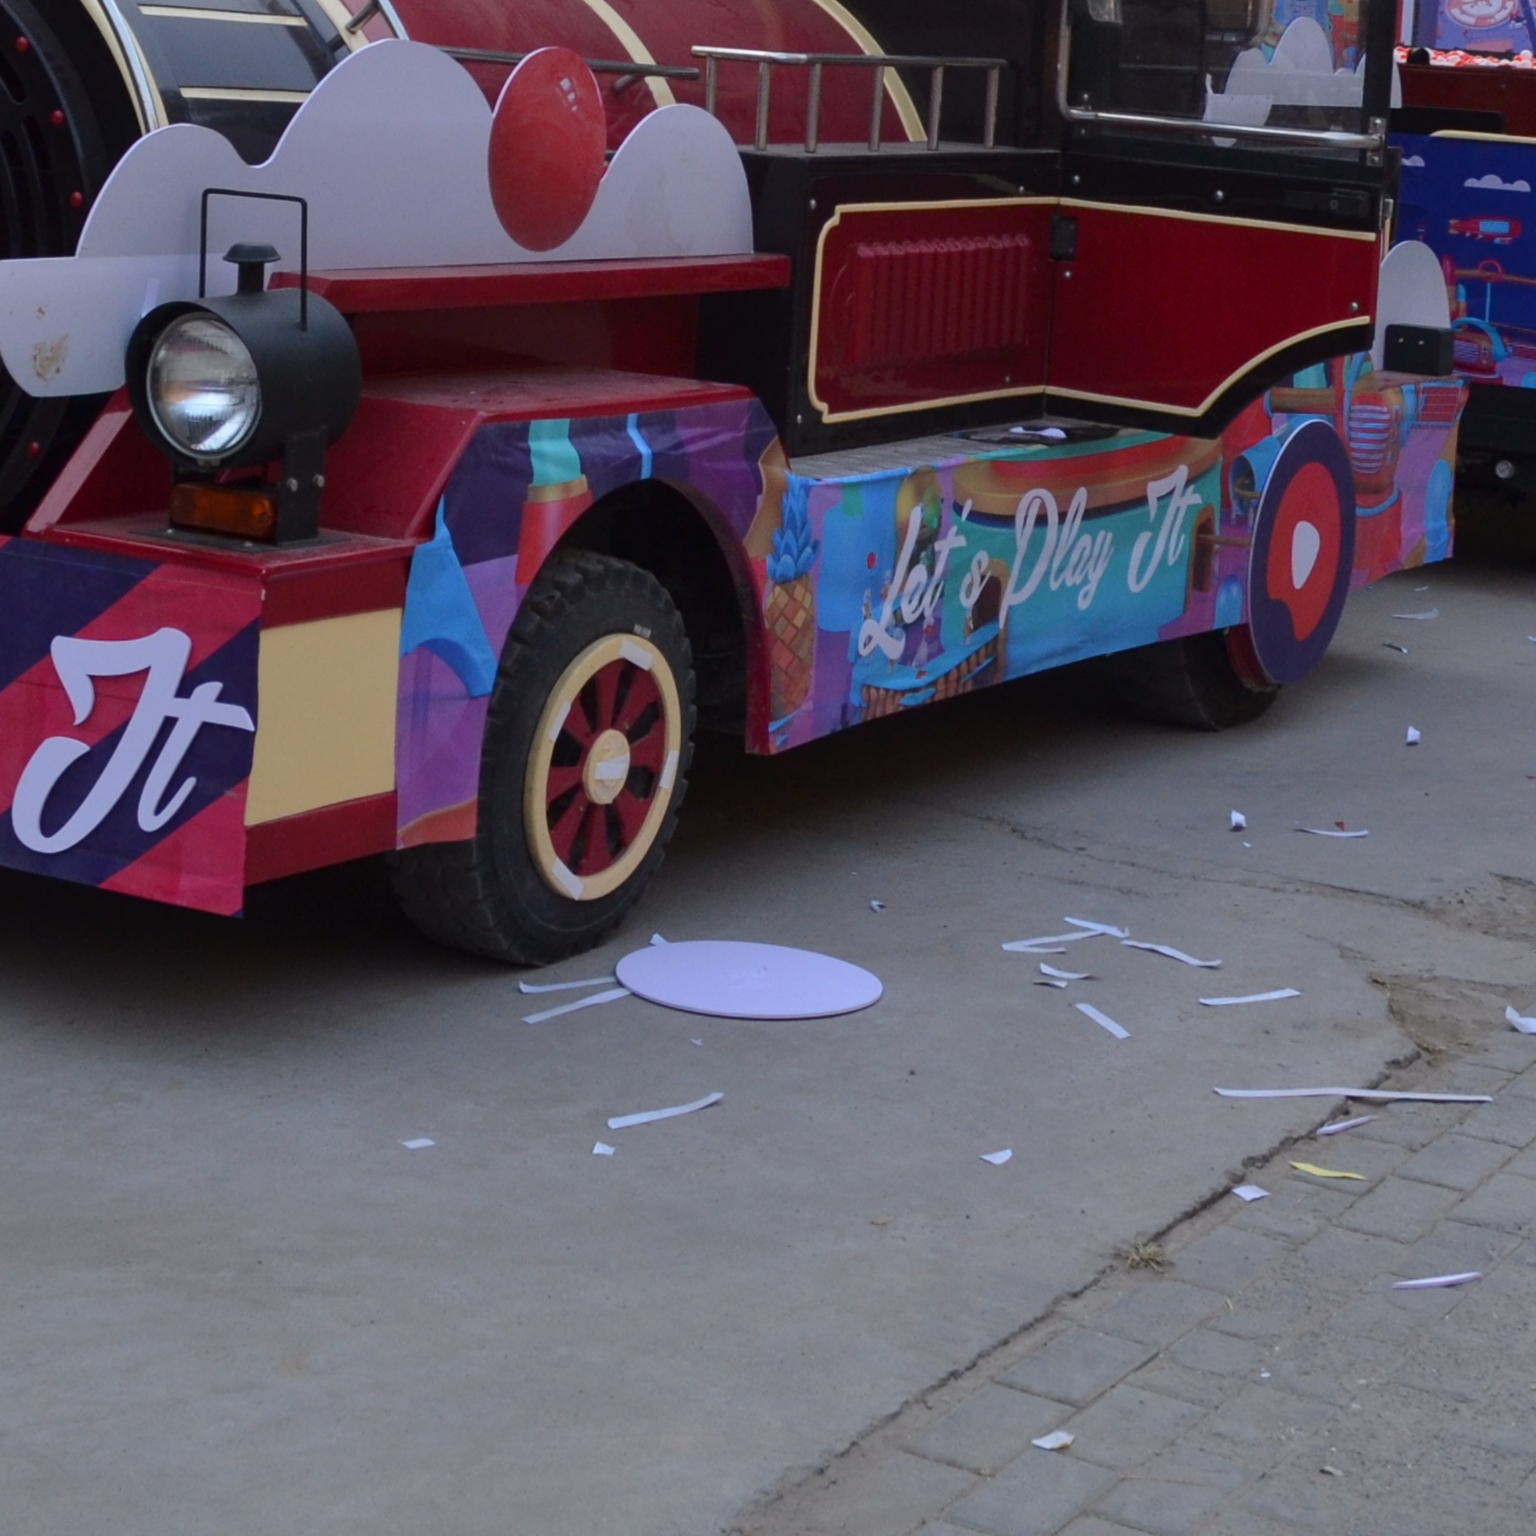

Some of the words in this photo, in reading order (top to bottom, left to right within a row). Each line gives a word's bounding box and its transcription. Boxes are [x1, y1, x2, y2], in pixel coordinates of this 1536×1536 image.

[858, 498, 991, 660] Let's
[998, 487, 1114, 630] Play
[1127, 464, 1202, 594] It
[10, 626, 255, 855] It
